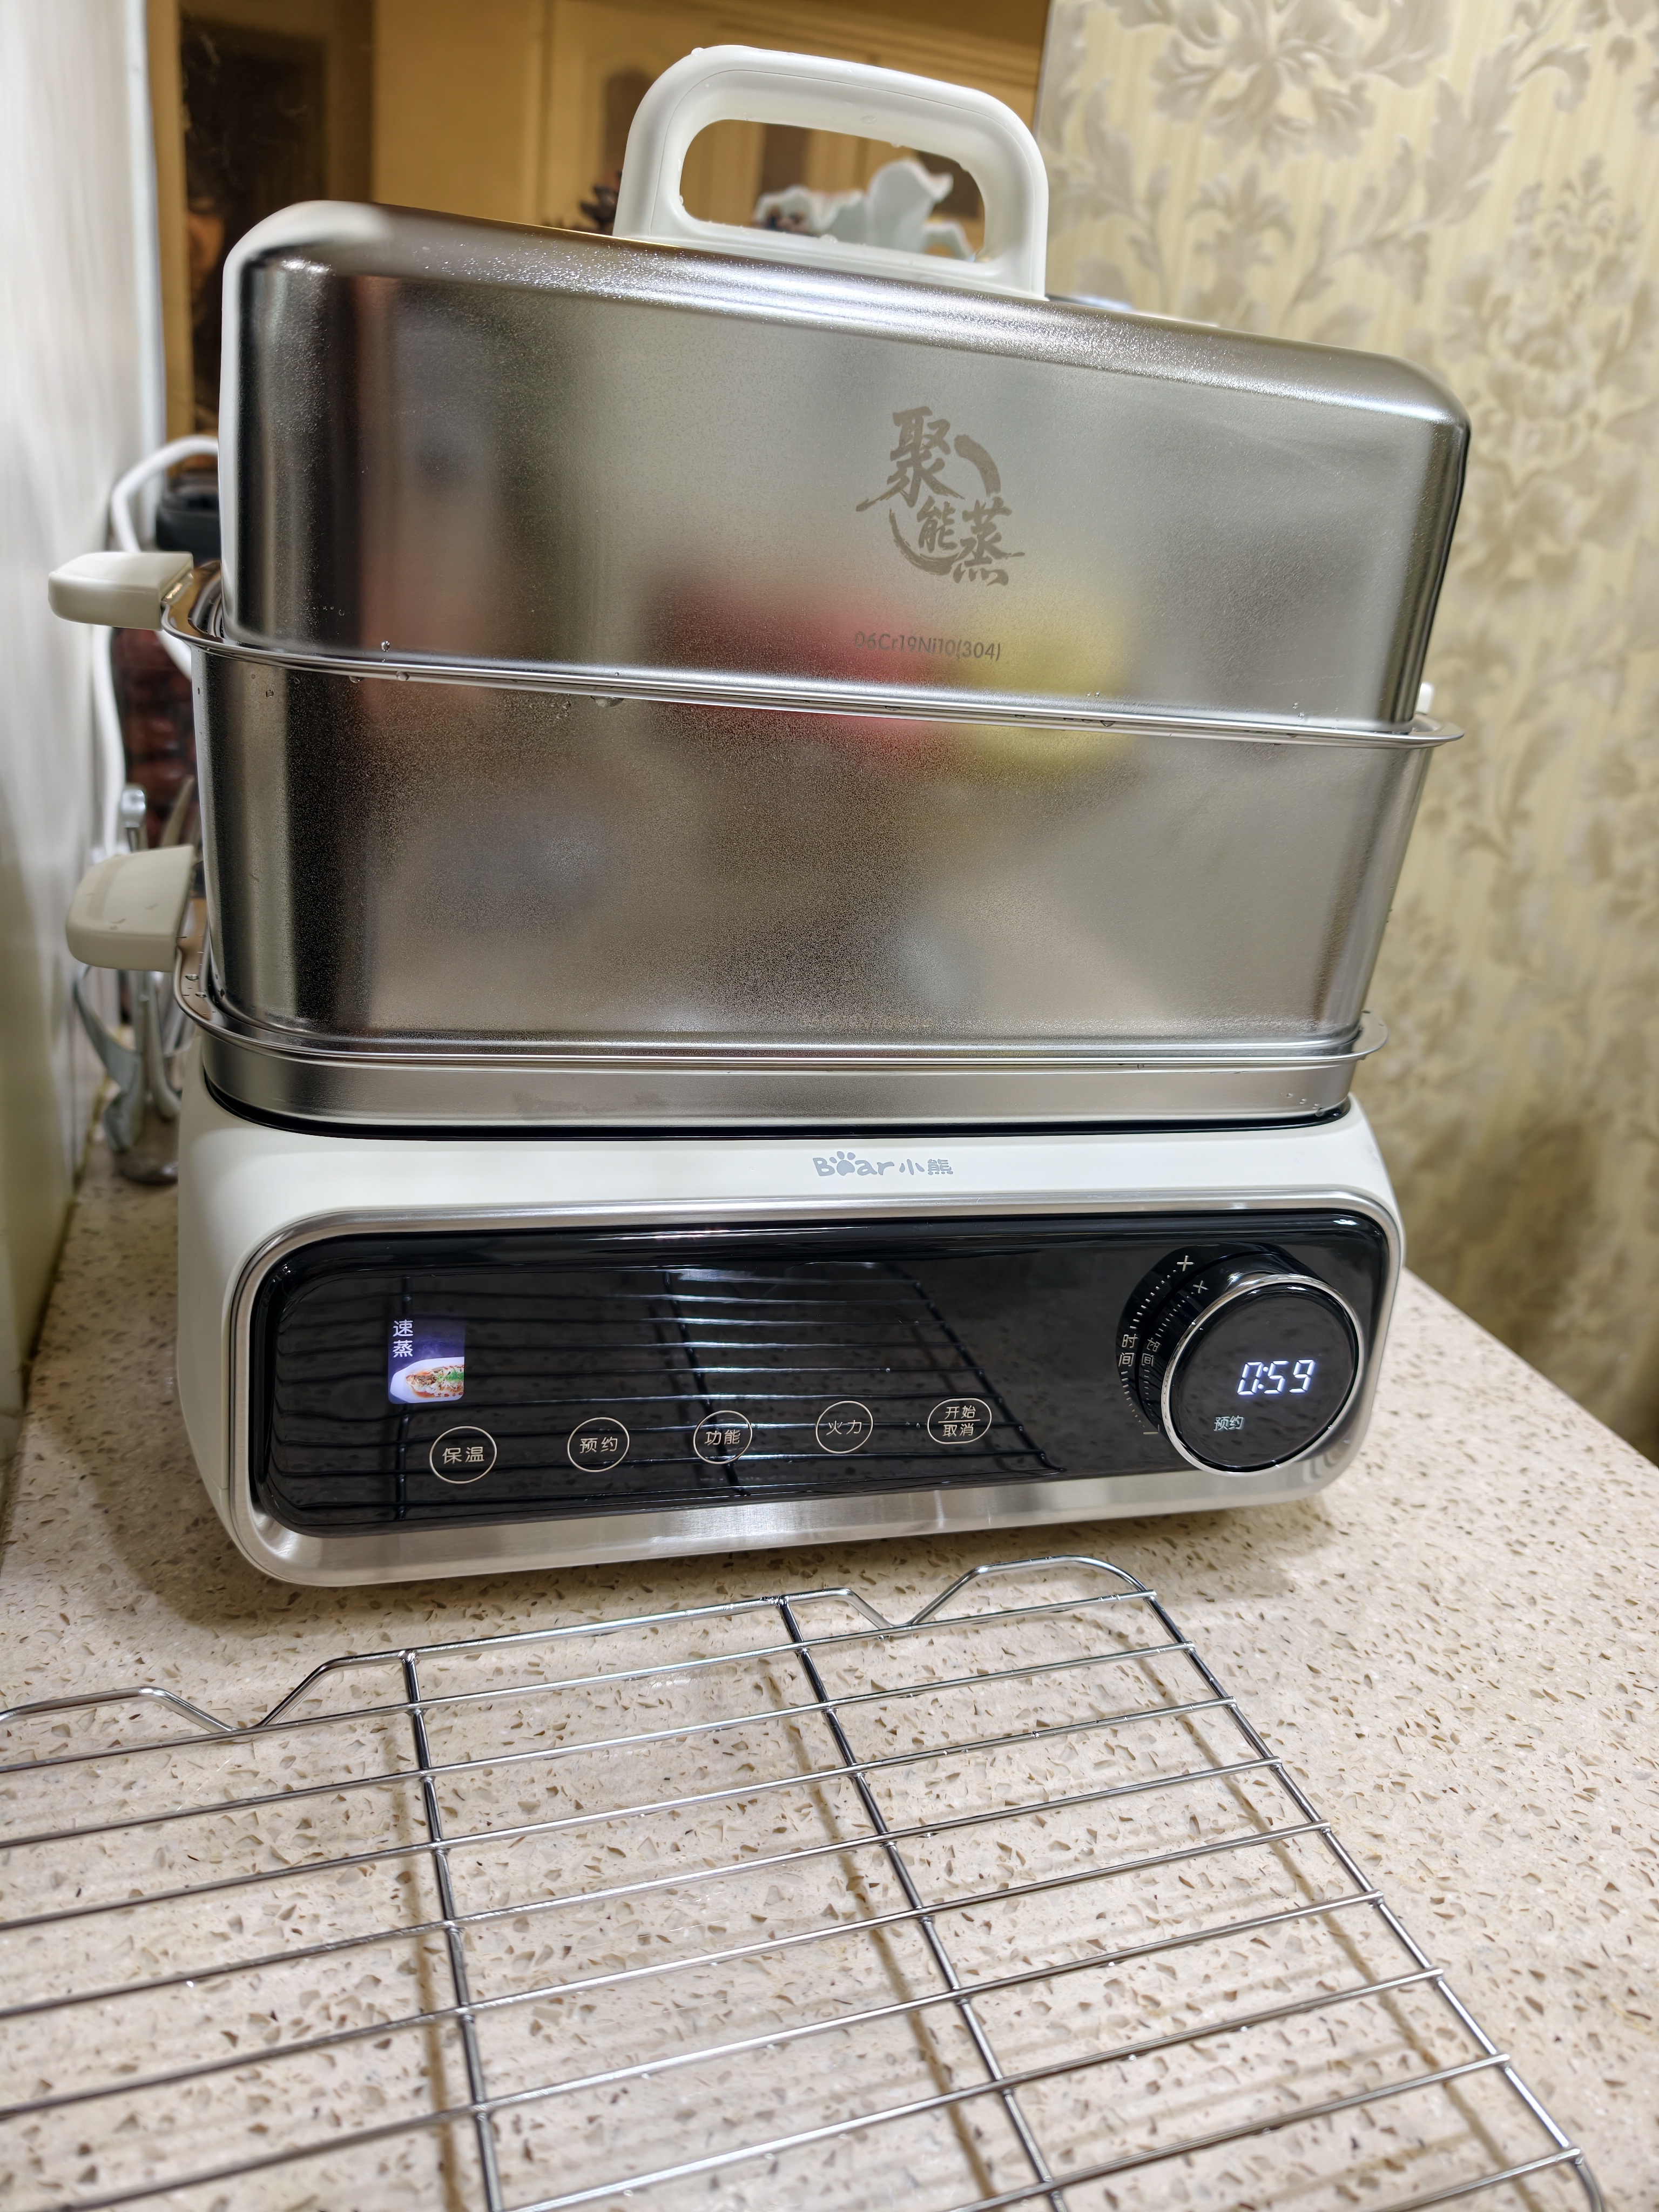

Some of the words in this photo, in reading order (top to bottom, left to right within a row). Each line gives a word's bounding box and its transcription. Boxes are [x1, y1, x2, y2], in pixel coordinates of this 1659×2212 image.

[854, 632, 1001, 661] 06Cr19Ni10(304)
[899, 1158, 953, 1175] 小熊
[393, 1319, 413, 1358] 速蒸
[1119, 1334, 1138, 1367] 时间
[1237, 1359, 1316, 1395] 0:59
[945, 1405, 976, 1419] 开始
[826, 1420, 862, 1435] 火力
[942, 1424, 974, 1437] 取消
[1213, 1415, 1245, 1432] 预约
[579, 1437, 618, 1454] 预约
[705, 1429, 741, 1446] 功能
[442, 1447, 485, 1464] 保温
